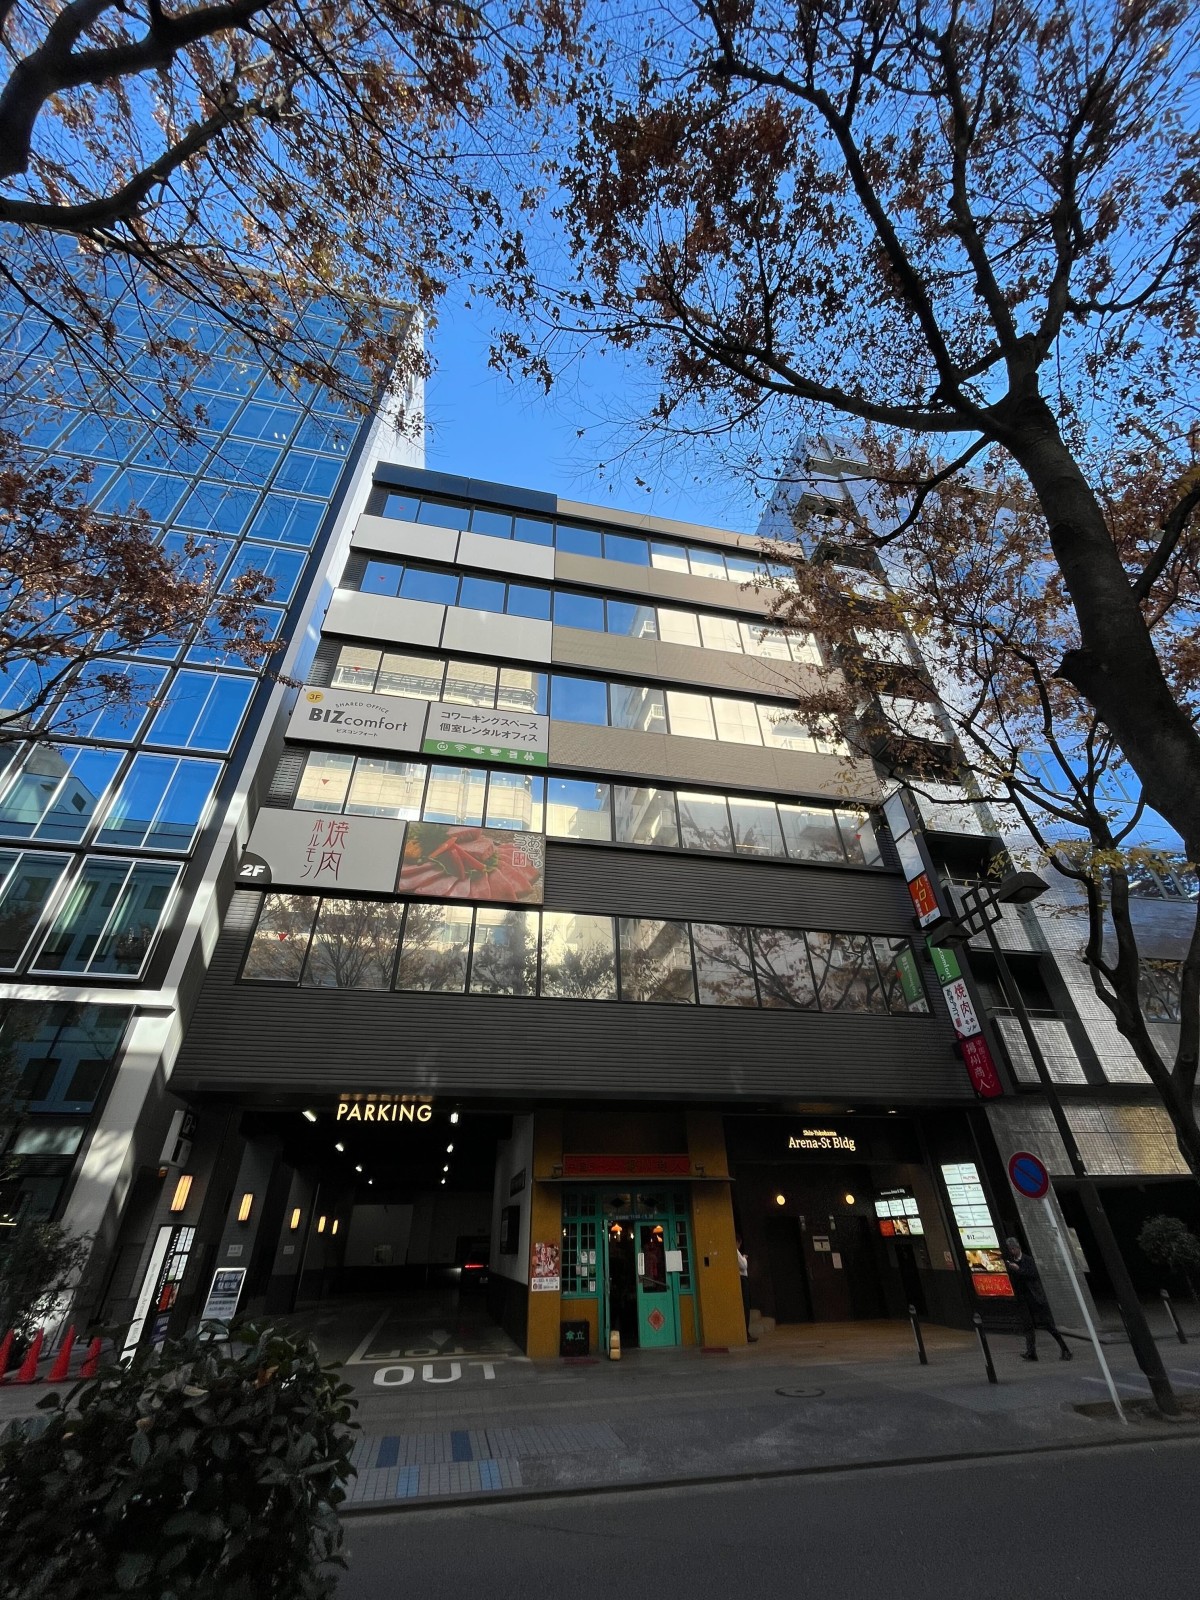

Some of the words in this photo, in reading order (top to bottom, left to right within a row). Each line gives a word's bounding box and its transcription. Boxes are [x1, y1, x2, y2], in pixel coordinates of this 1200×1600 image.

[309, 693, 322, 701] 3F
[335, 701, 364, 709] SHARED
[366, 703, 390, 714] OFFICE
[441, 711, 538, 730] コワーキングスペース
[440, 722, 538, 742] 個室レンタルオフィス
[300, 819, 324, 878] ホルモン
[313, 820, 349, 881] 焼肉
[239, 864, 266, 877] 2F
[953, 983, 972, 1018] 焼肉
[965, 1041, 991, 1092] 揚州商人
[336, 1103, 432, 1122] PARKING
[788, 1136, 832, 1149] Arena-St
[832, 1136, 856, 1152] Bldg
[373, 1361, 505, 1386] OUT
